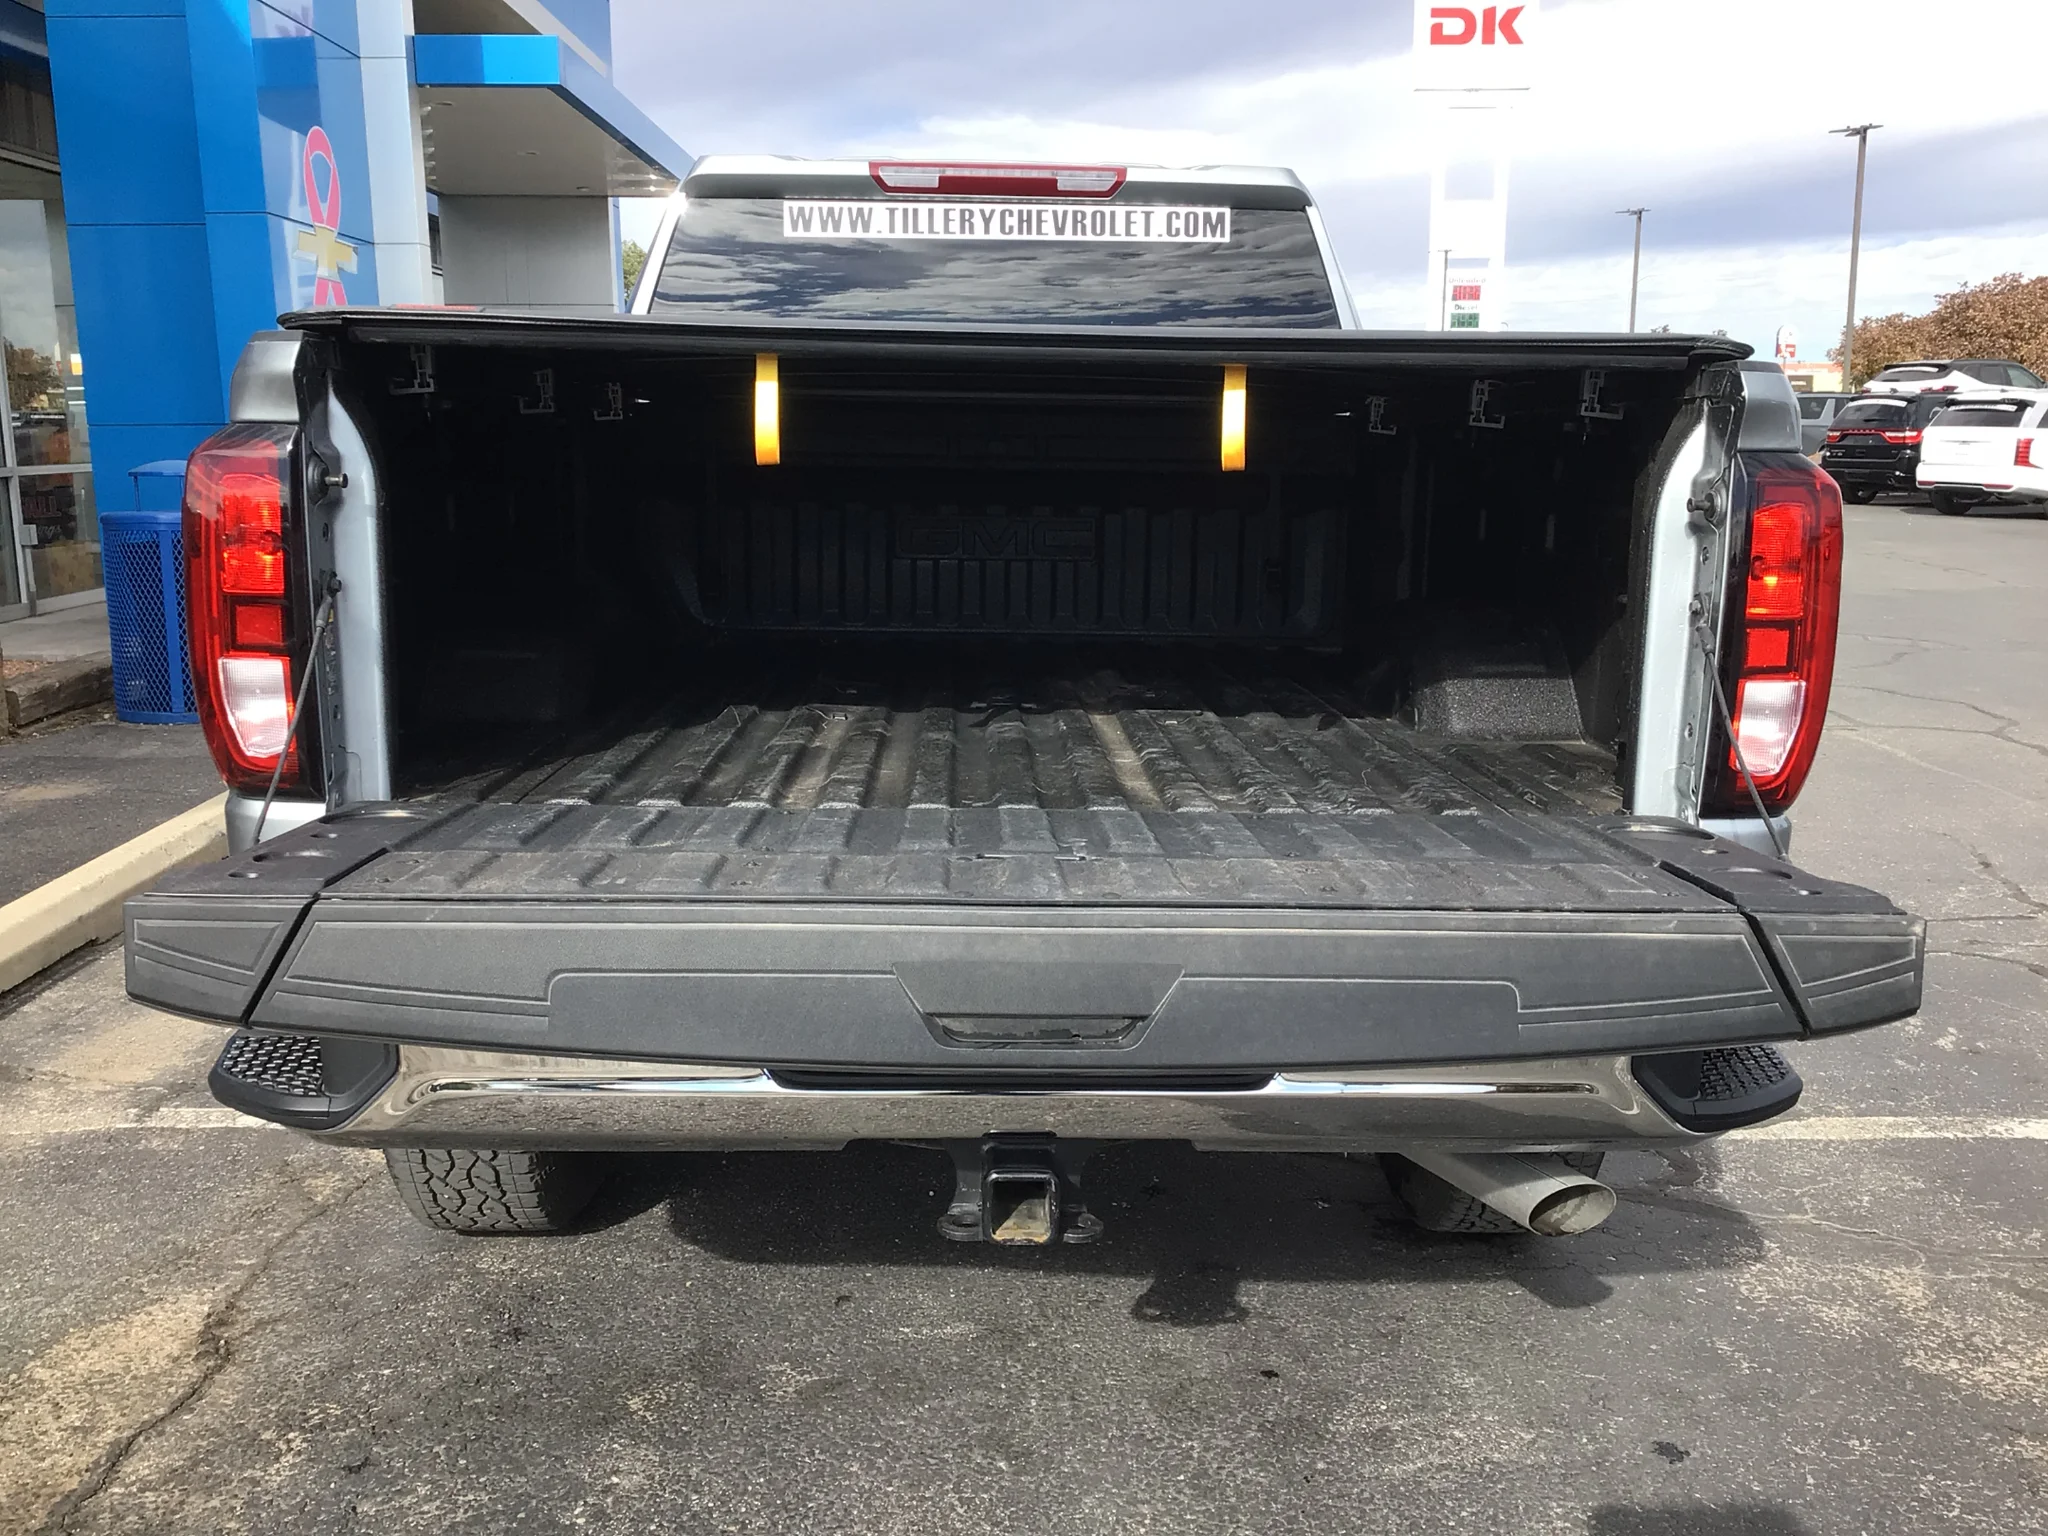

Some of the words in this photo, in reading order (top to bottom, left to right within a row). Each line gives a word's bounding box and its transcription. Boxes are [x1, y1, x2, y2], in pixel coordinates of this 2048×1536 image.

[1430, 5, 1525, 45] DK
[788, 206, 1226, 238] WWW.TILLERYCHEVROLET.COM
[899, 519, 1095, 556] GMC
